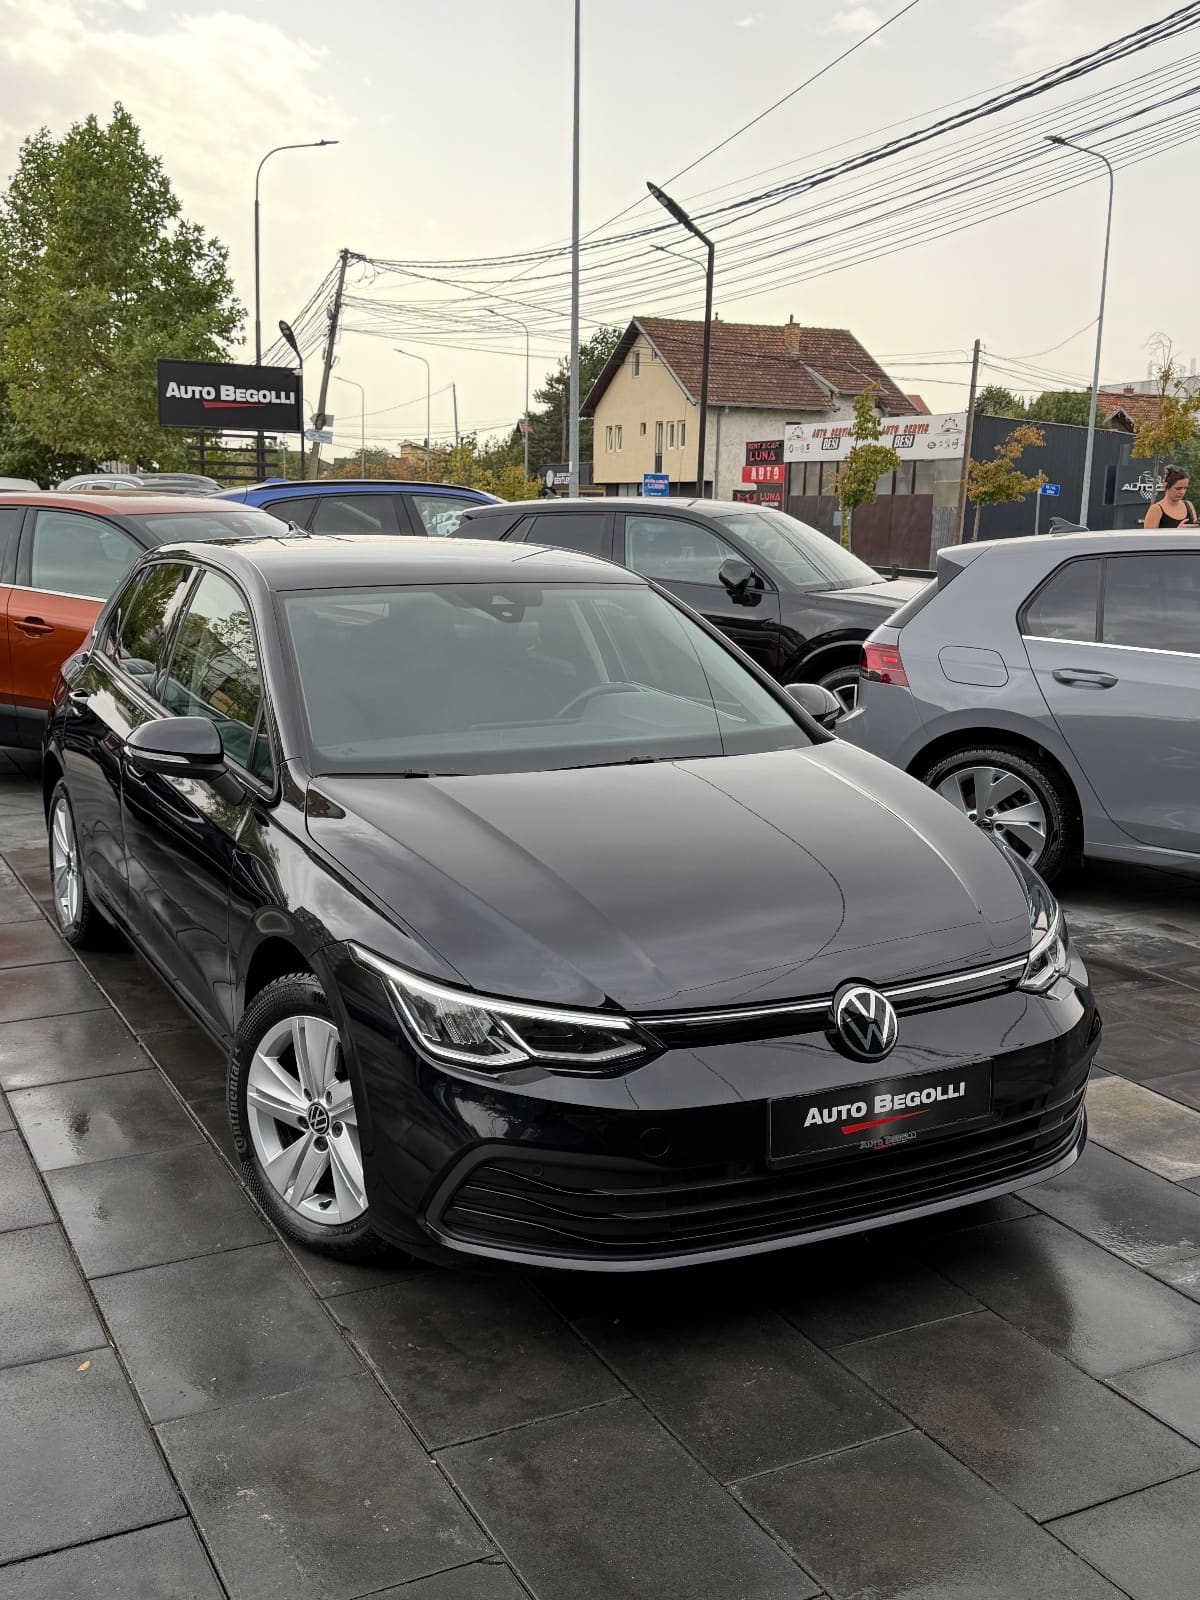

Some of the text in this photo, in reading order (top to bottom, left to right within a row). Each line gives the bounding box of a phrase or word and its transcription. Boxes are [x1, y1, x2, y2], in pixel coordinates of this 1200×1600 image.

[165, 381, 295, 405] AUTO BEGOLLI
[812, 428, 828, 438] AUTO
[822, 437, 839, 450] BESI
[894, 434, 913, 448] BESI
[749, 450, 776, 461] LUNA
[751, 466, 779, 480] AUTO
[1121, 482, 1154, 491] AUTO
[760, 492, 781, 501] LUNA
[229, 1058, 247, 1153] Continental
[803, 1081, 966, 1127] AUTO BEGOLLI
